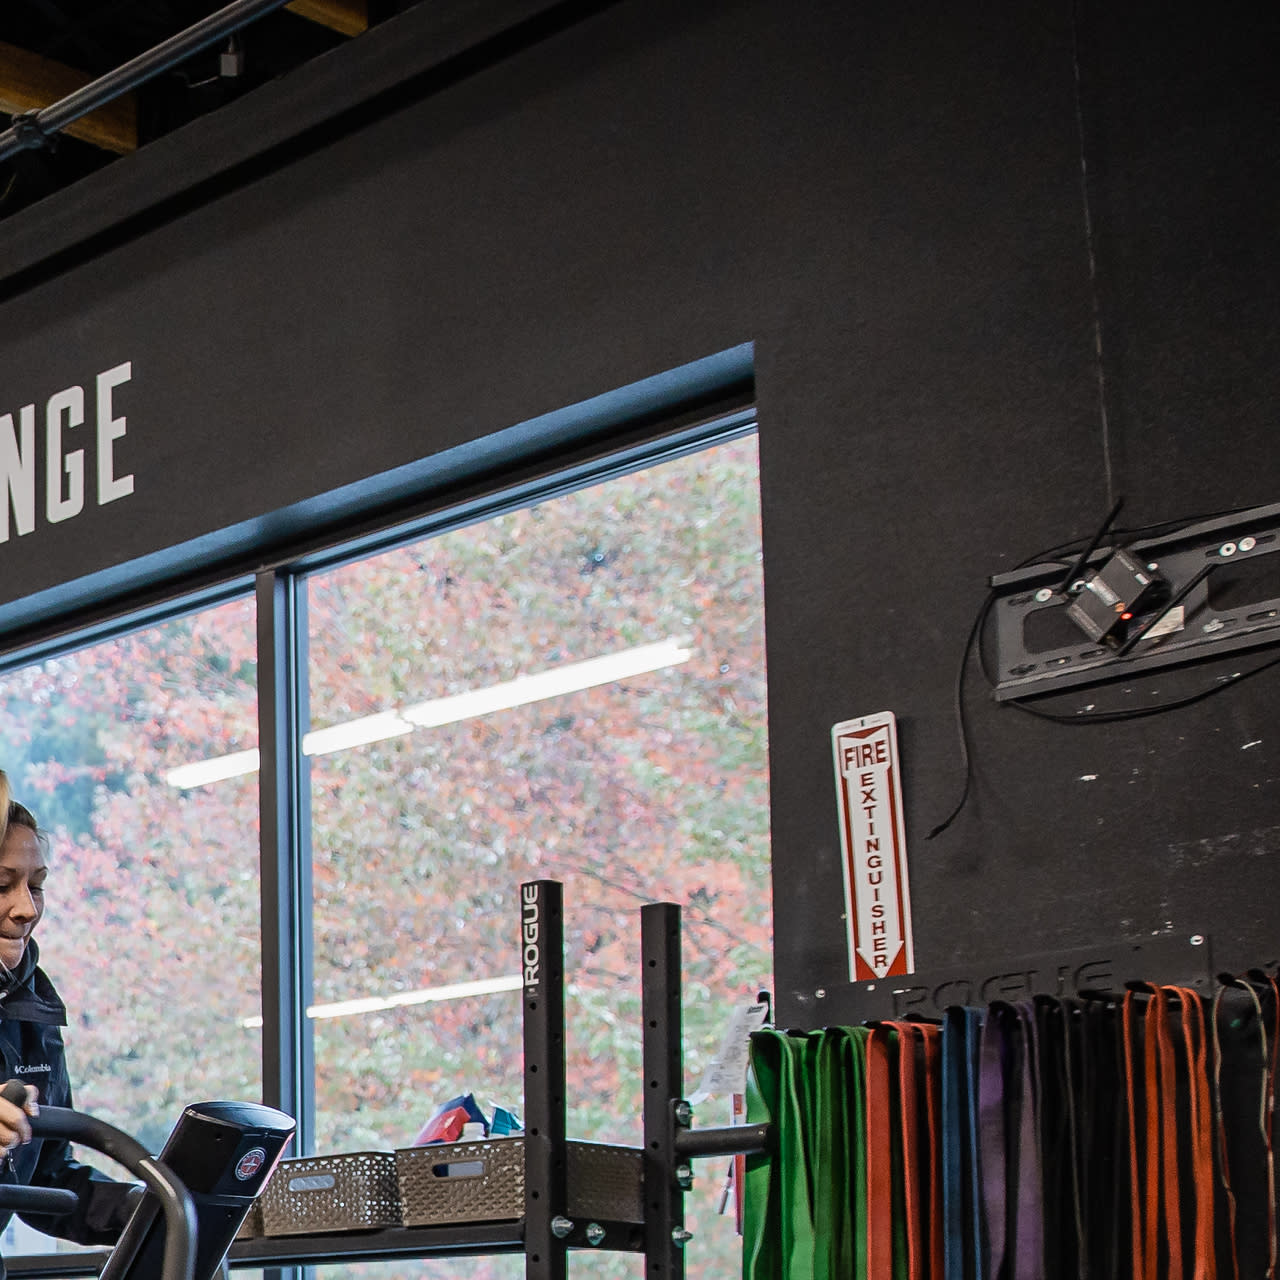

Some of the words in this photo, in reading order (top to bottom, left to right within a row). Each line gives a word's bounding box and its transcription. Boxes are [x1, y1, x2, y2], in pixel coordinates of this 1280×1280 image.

[844, 740, 887, 771] FIRE
[859, 771, 889, 969] EXTINGUISHER
[523, 885, 540, 986] ROGUE
[19, 1064, 52, 1074] Columbia
